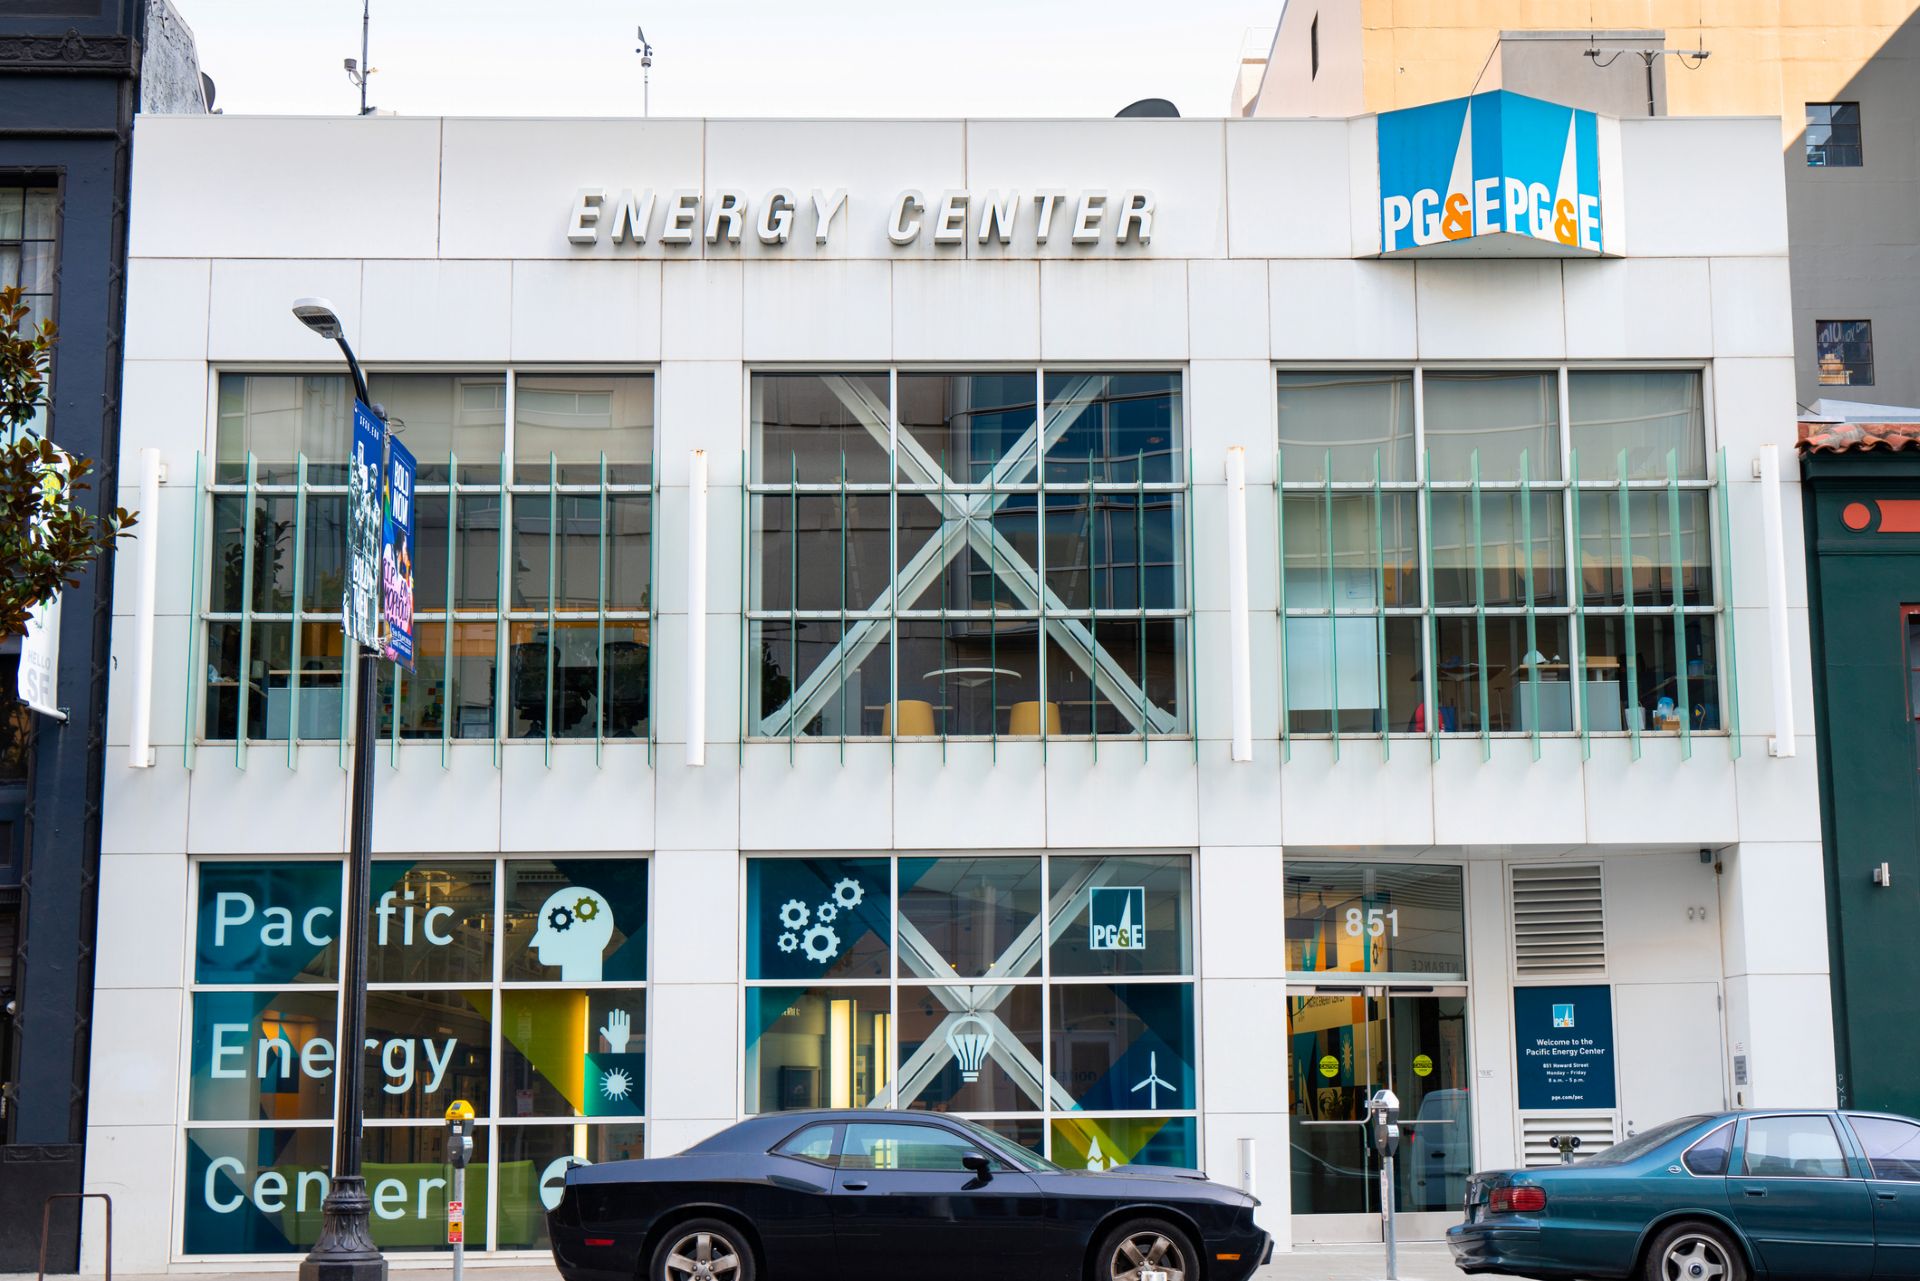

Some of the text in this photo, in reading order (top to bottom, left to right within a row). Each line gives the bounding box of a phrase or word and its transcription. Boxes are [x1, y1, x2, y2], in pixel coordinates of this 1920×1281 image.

[567, 188, 1156, 246] ENERGY CENTER
[1383, 176, 1500, 252] PG&E
[1504, 176, 1600, 251] PG&E
[394, 460, 409, 497] BOLD
[392, 488, 409, 527] NOW
[28, 649, 51, 670] HELLO
[27, 668, 50, 706] SF
[214, 890, 455, 947] Pacfic
[1093, 924, 1142, 948] PG&E
[1345, 907, 1399, 937] 851
[1526, 1047, 1605, 1057] Pacific Energy Center
[1536, 1038, 1570, 1046] Welcome
[1571, 1038, 1580, 1046] to
[203, 1156, 447, 1220] Cener
